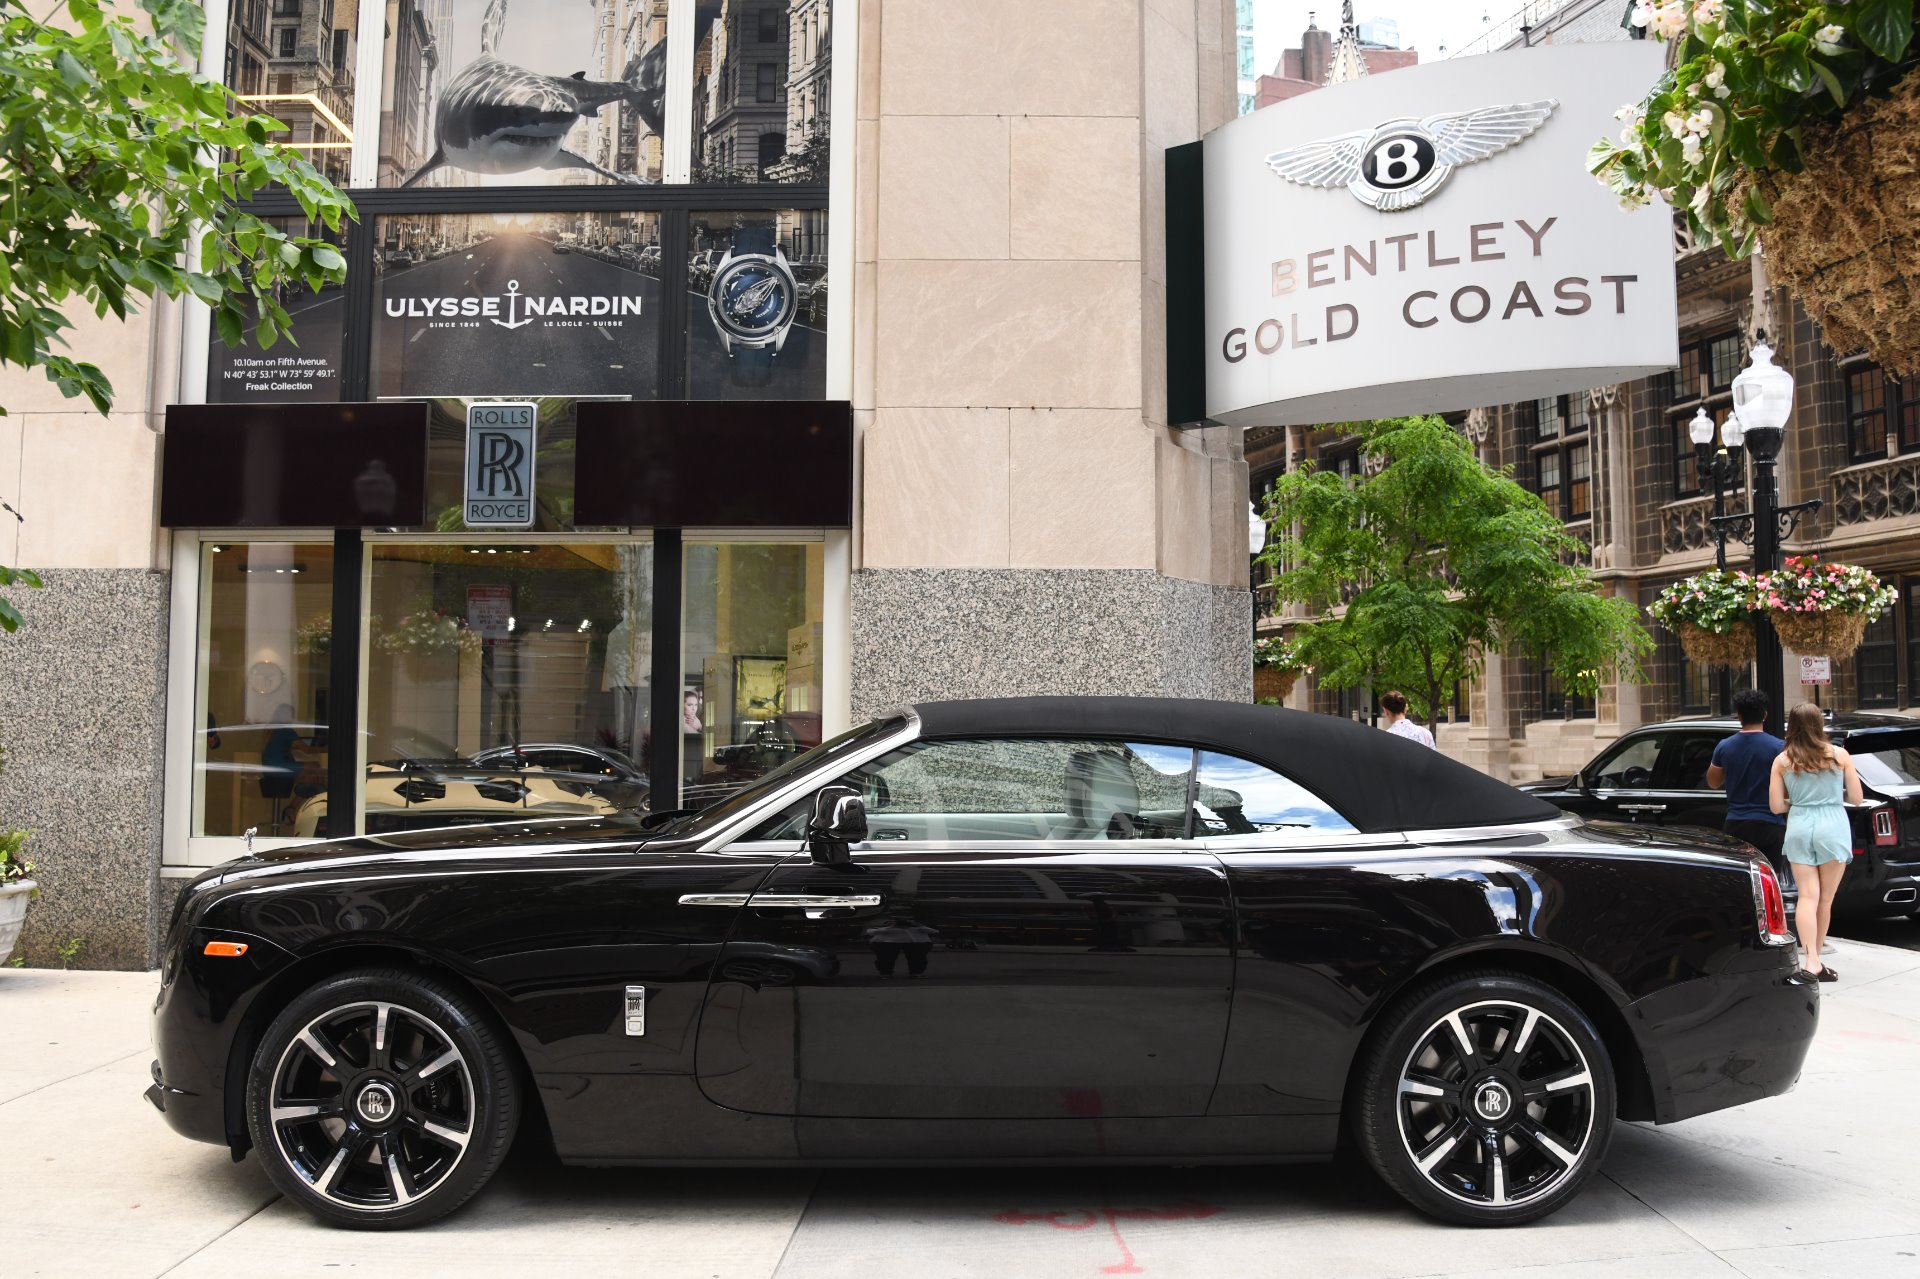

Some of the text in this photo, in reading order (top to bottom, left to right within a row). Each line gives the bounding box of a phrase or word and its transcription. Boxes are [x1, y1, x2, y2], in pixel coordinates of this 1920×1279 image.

[1271, 217, 1558, 297] BENTLEY
[386, 296, 642, 317] ULYSSE NARDIN
[1222, 274, 1638, 363] GOLD COAST
[233, 358, 264, 366] 10.10am
[278, 357, 295, 366] Fifth
[297, 358, 328, 366] Avenue.
[232, 370, 246, 378] 40°
[279, 370, 288, 378] W
[290, 370, 302, 378] 73°
[245, 382, 313, 391] Freak Collection
[474, 410, 528, 424] ROLLS
[476, 432, 524, 496] RR
[471, 504, 525, 518] ROYCE
[1485, 1090, 1501, 1112] RR
